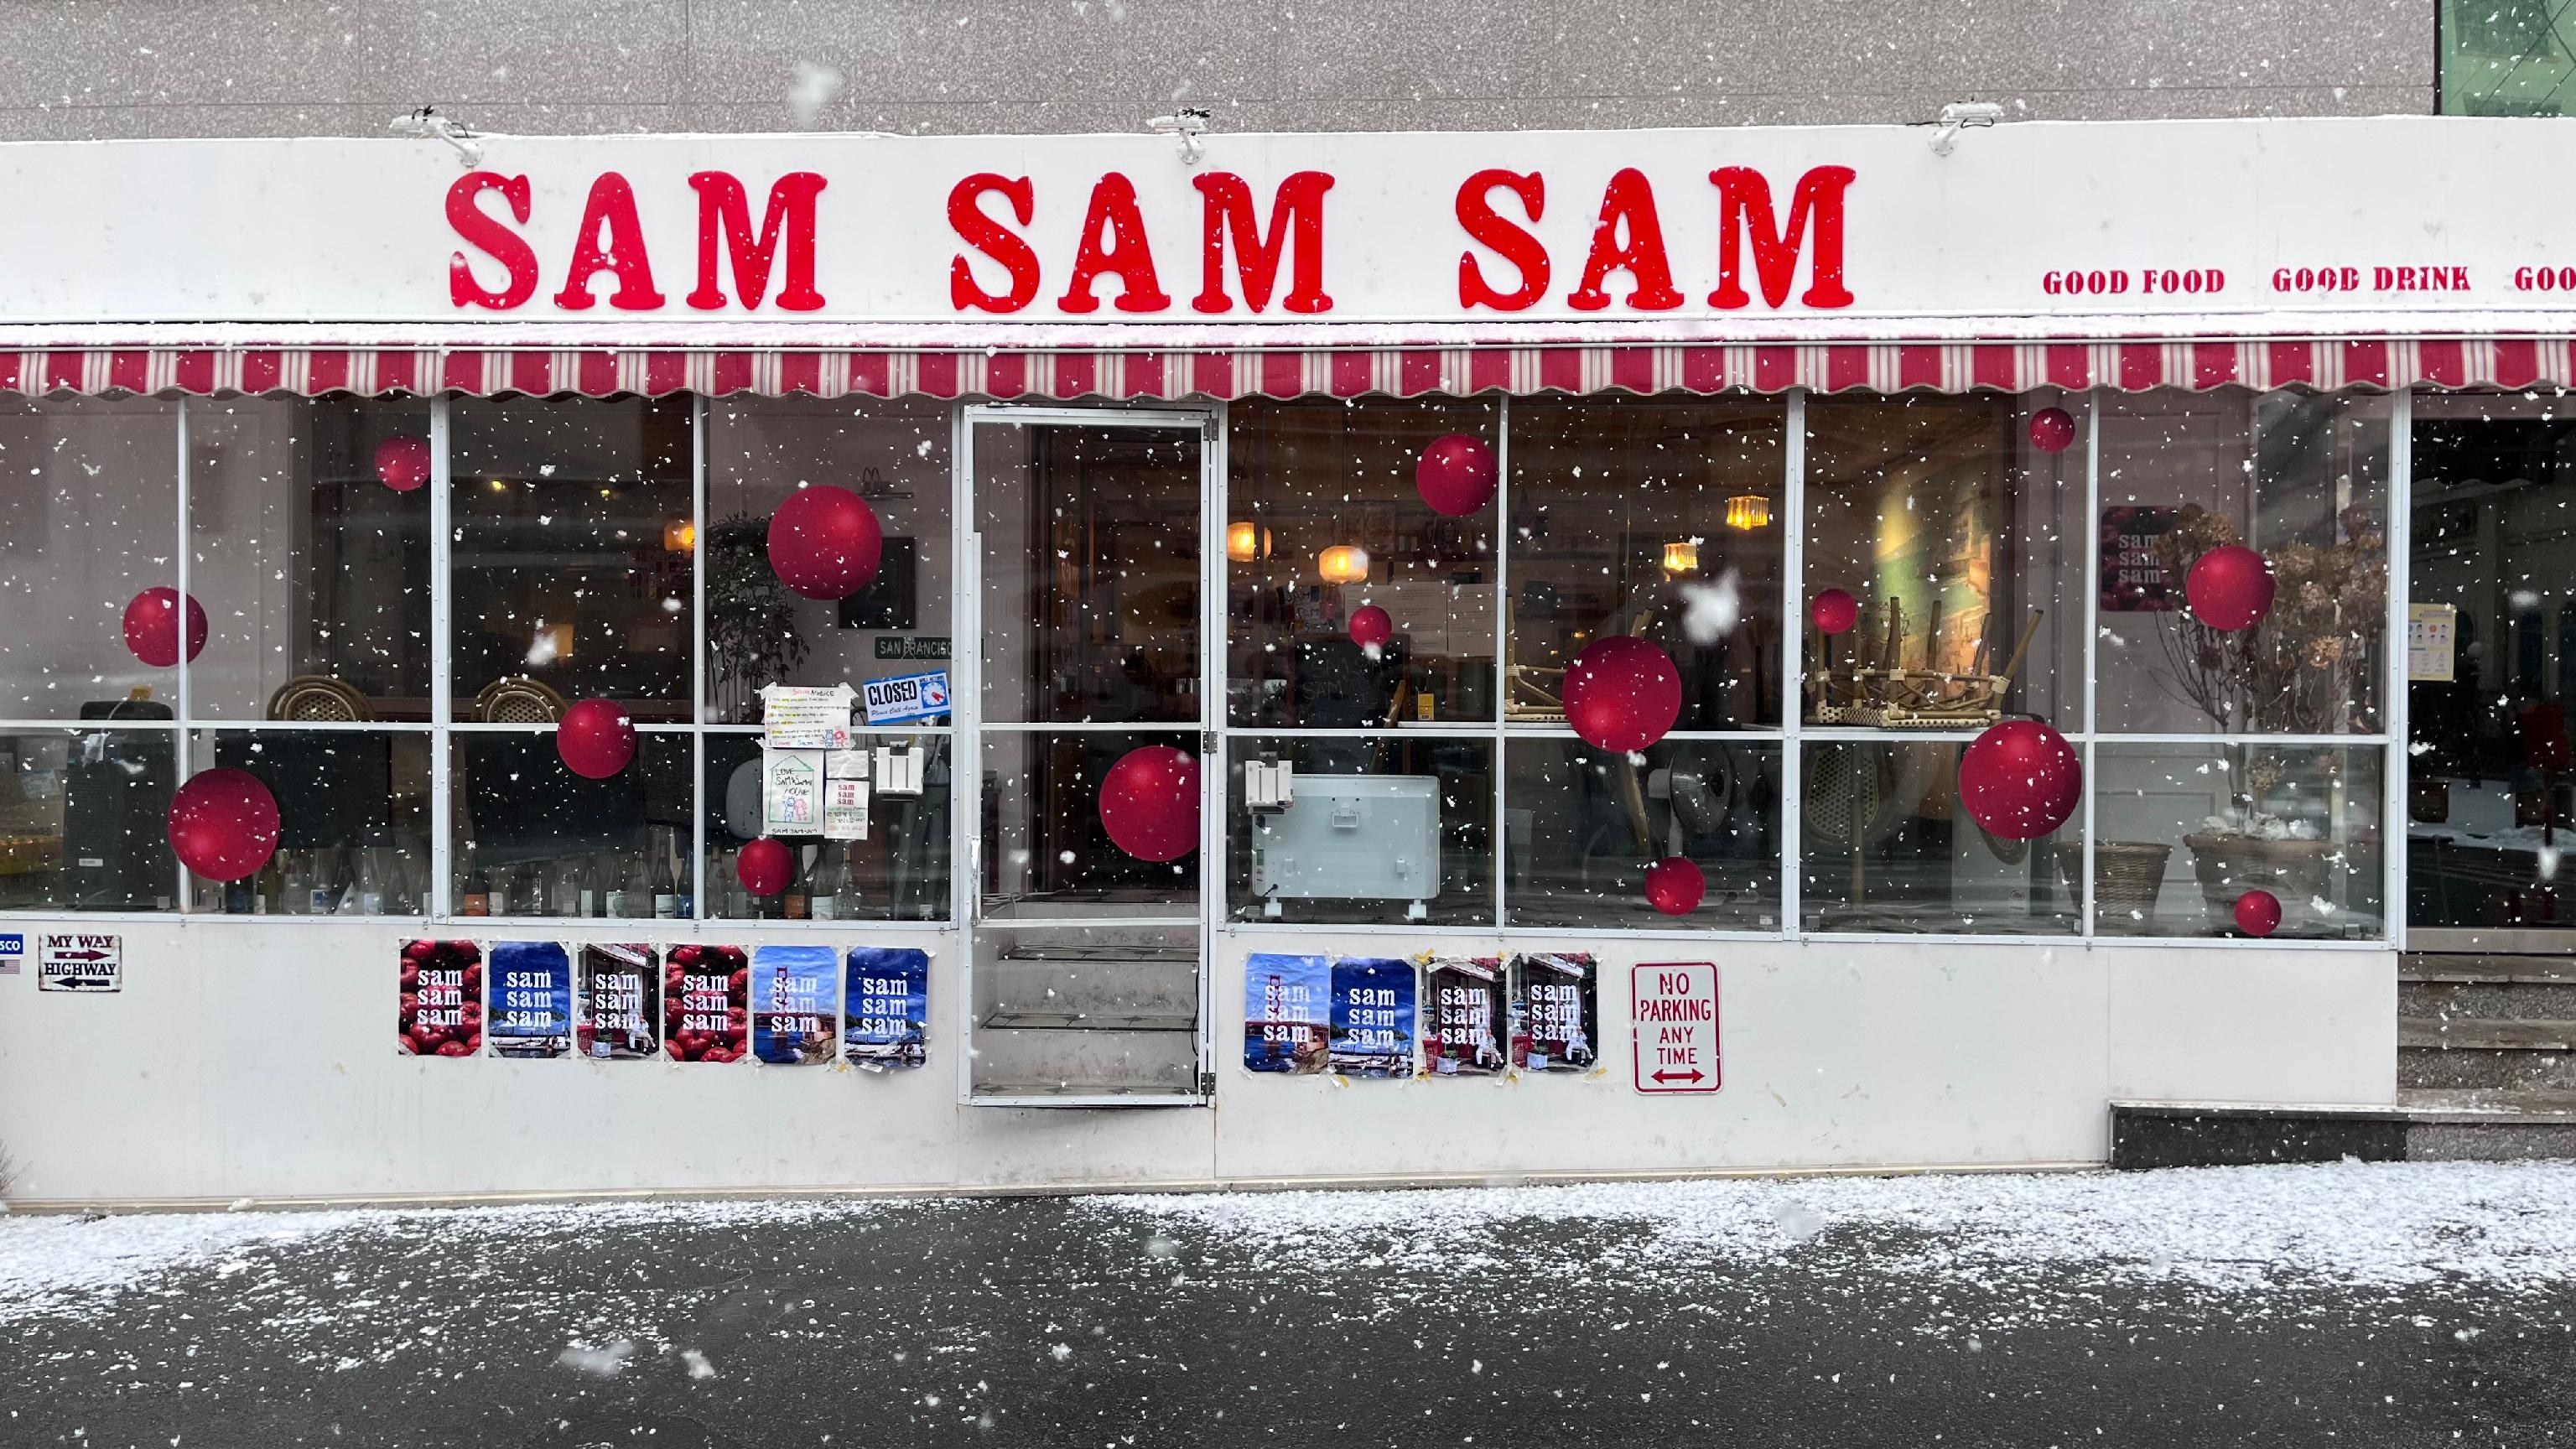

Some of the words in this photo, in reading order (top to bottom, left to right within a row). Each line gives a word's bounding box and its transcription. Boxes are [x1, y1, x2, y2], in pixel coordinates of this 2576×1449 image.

[446, 171, 828, 311] SAM
[948, 171, 1335, 314] SAM
[1456, 165, 1856, 311] SAM
[2044, 271, 2128, 293] GOOD
[2144, 270, 2224, 293] FOOD
[2273, 268, 2359, 291] GOOD
[2375, 267, 2470, 290] DRINK
[2516, 268, 2576, 289] GOO
[2119, 569, 2160, 584] sam
[880, 641, 901, 654] SAN
[903, 641, 952, 656] FRANCISC
[868, 680, 917, 706] CLOSED
[0, 940, 20, 951] SCO
[47, 935, 73, 948] MY
[77, 936, 114, 948] WAY
[44, 963, 117, 975] HIGHWAY
[418, 969, 463, 986] sam
[506, 971, 552, 989] sam
[595, 973, 640, 990] sam
[683, 974, 729, 992] sam
[772, 976, 817, 994] sam
[863, 978, 908, 996] sam
[1659, 973, 1690, 995] NO
[417, 988, 462, 1006] sam
[506, 990, 552, 1008] sam
[595, 992, 639, 1010] sam
[1265, 984, 1310, 1003] sam
[1349, 987, 1395, 1007] sam
[1441, 987, 1487, 1005] sam
[1531, 983, 1577, 1001] sam
[683, 995, 729, 1011] sam
[771, 995, 817, 1013] sam
[862, 998, 907, 1015] sam
[1531, 1003, 1577, 1021] sam
[1640, 1000, 1711, 1021] PARKING
[417, 1007, 462, 1026] sam
[506, 1010, 552, 1027] sam
[595, 1012, 639, 1030] sam
[1264, 1004, 1310, 1022] sam
[1348, 1007, 1395, 1027] sam
[1441, 1006, 1487, 1025] sam
[683, 1014, 728, 1031] sam
[771, 1015, 818, 1033] sam
[862, 1017, 906, 1036] sam
[1531, 1022, 1577, 1041] sam
[1264, 1023, 1309, 1042] sam
[1348, 1028, 1394, 1046] sam
[1441, 1026, 1487, 1045] sam
[1659, 1026, 1694, 1044] ANY
[1657, 1047, 1697, 1065] TIME
